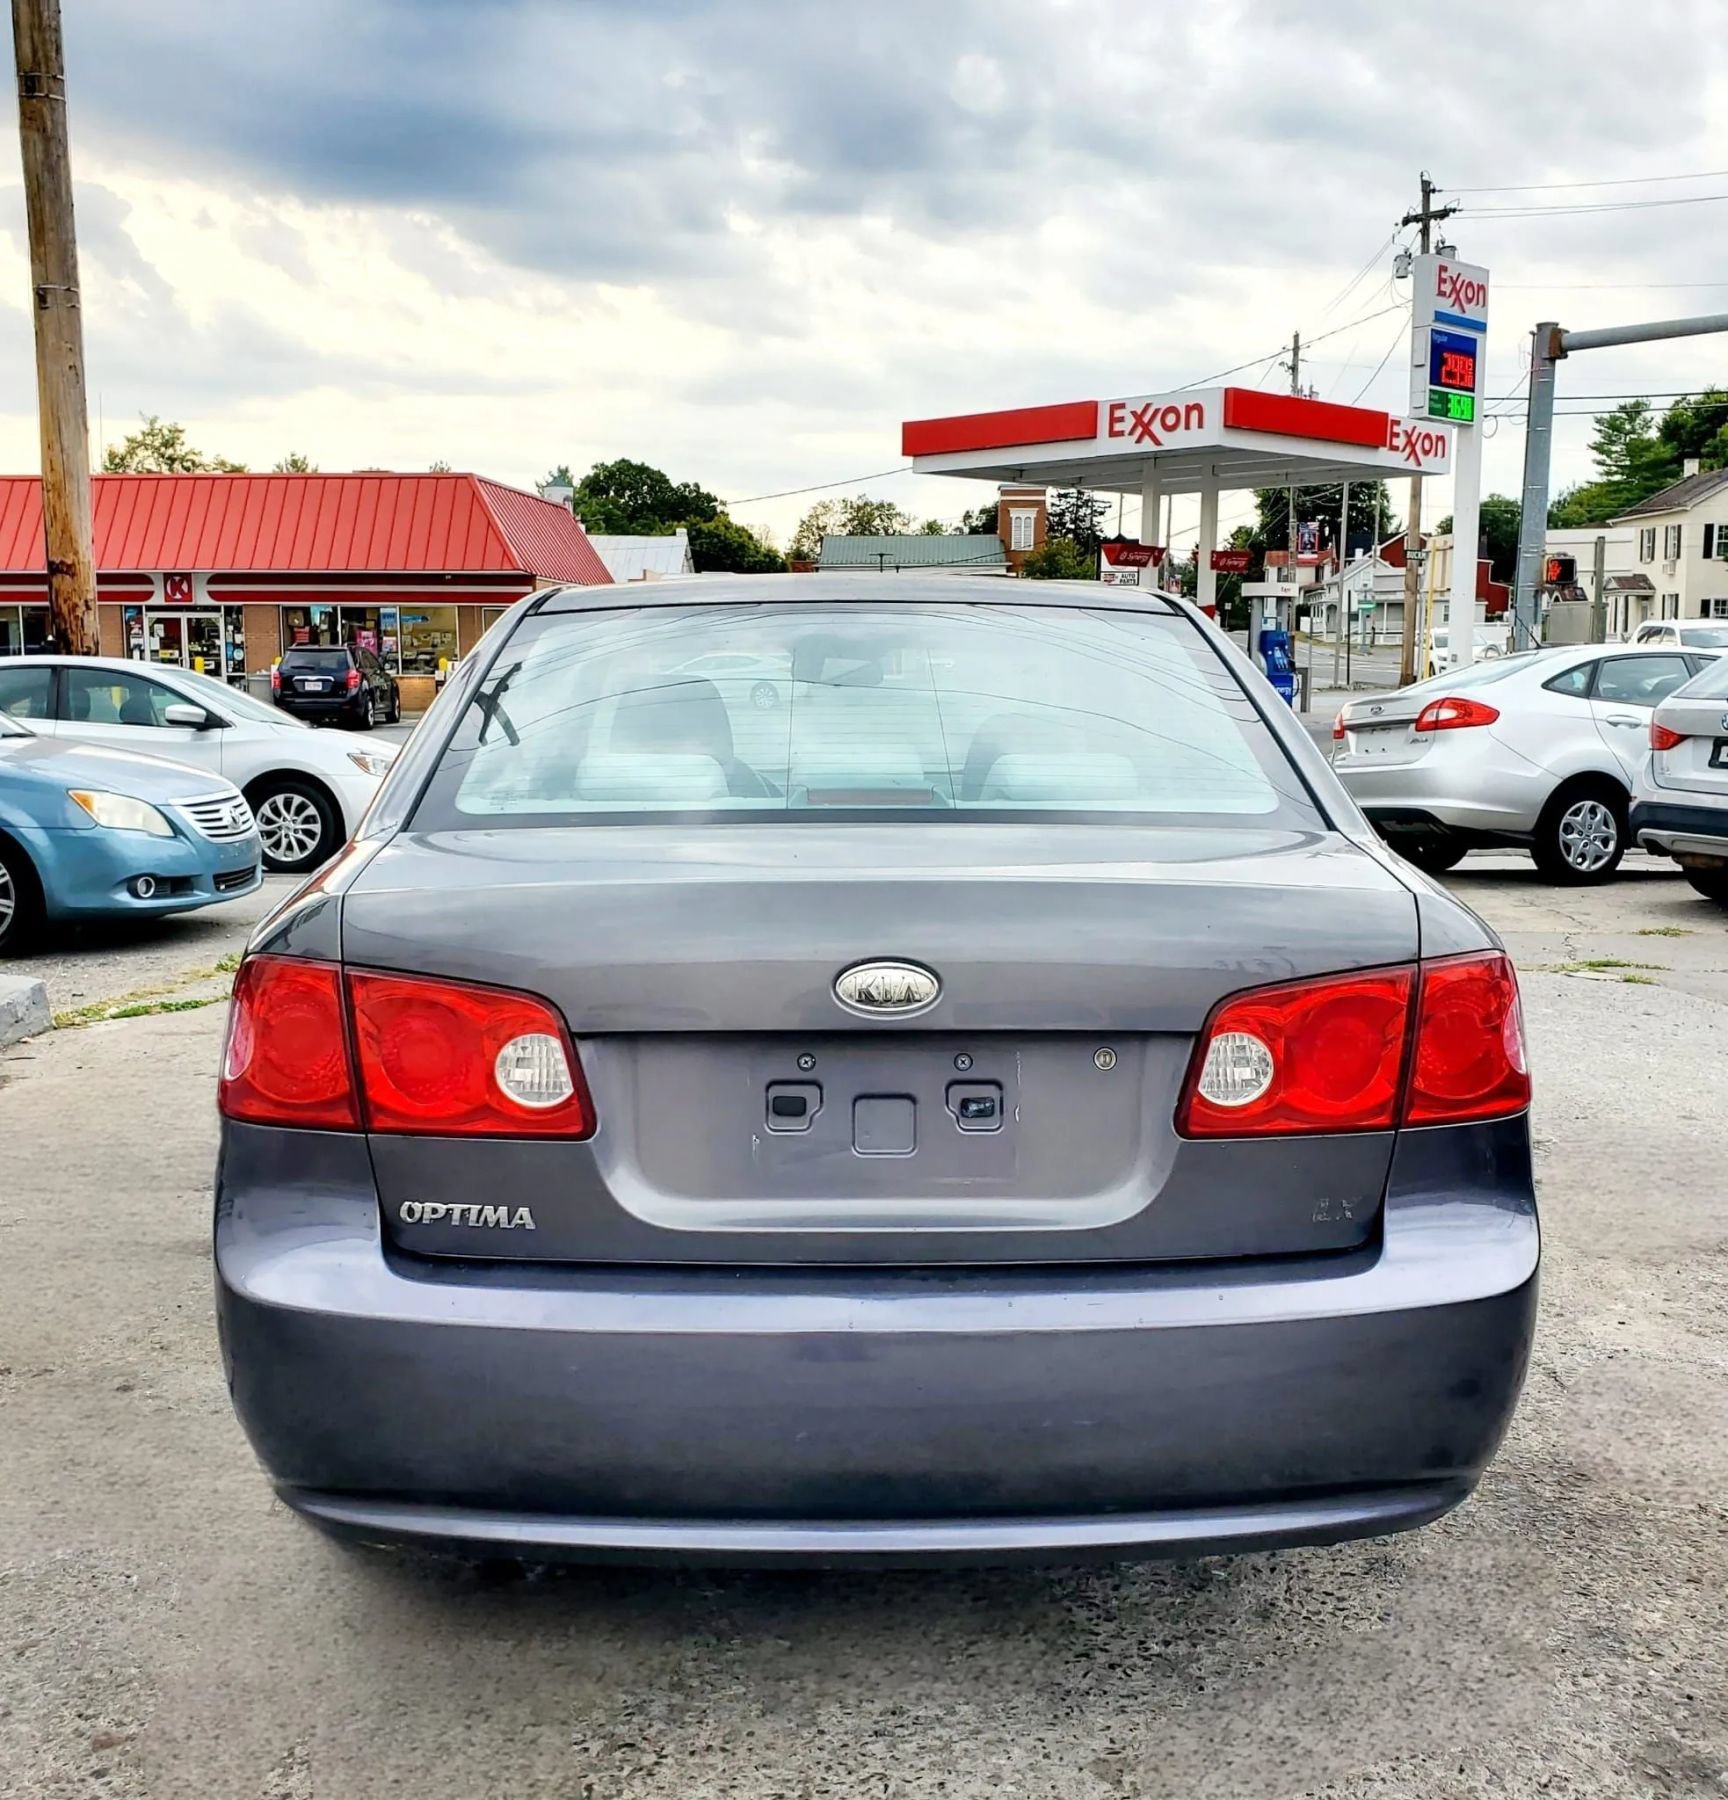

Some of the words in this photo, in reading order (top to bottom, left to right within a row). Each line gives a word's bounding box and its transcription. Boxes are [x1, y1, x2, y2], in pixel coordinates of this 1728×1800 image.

[1436, 264, 1487, 313] Exxon
[1108, 401, 1204, 446] Exxon
[1387, 419, 1446, 466] Exxon
[854, 975, 923, 1004] KIA
[400, 1201, 536, 1230] OPTIMA
